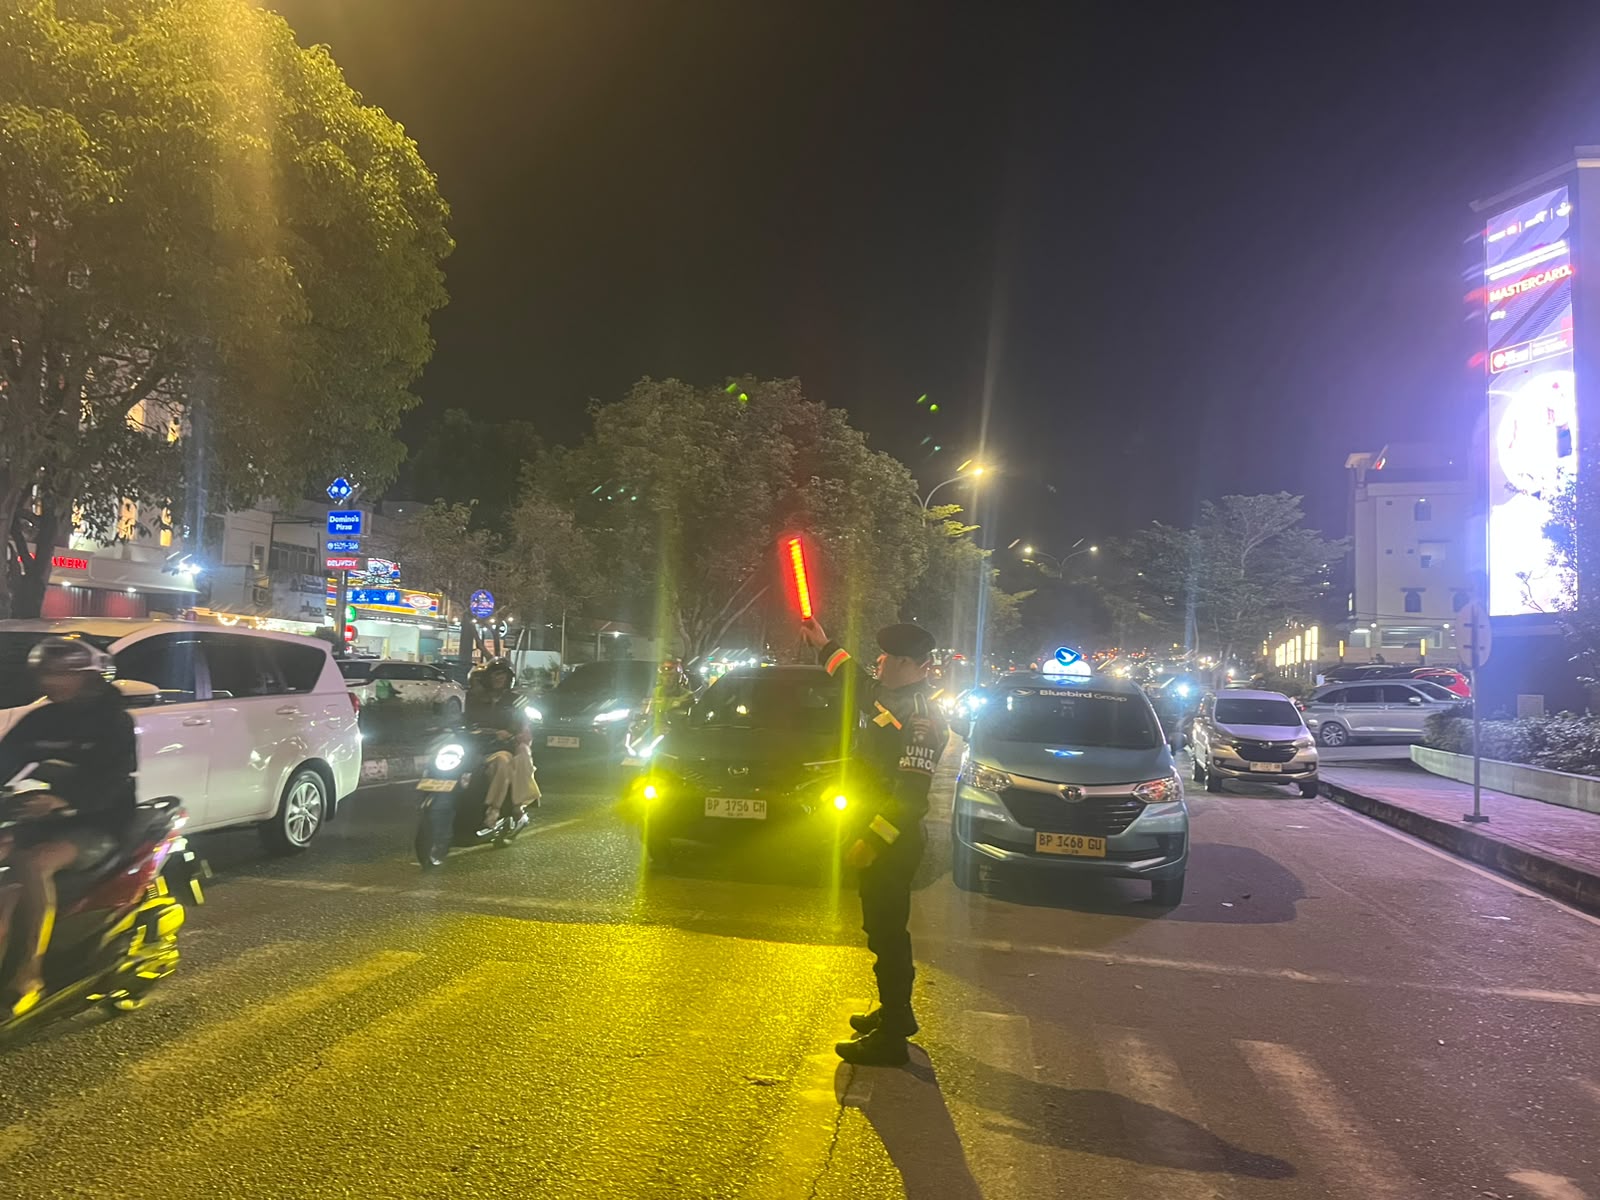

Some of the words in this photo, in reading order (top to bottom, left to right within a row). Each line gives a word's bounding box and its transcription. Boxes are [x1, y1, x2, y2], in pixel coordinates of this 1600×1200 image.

[329, 515, 359, 523] Domino's
[52, 556, 88, 570] AKERY
[1040, 689, 1093, 699] Bluebird
[1094, 693, 1127, 702] Group
[906, 745, 935, 759] UNIT
[899, 756, 935, 773] PATRO
[707, 799, 720, 811] BP
[725, 800, 749, 812] 1756
[1039, 834, 1053, 846] BP
[1056, 835, 1084, 849] 1468
[1088, 838, 1102, 850] GU
